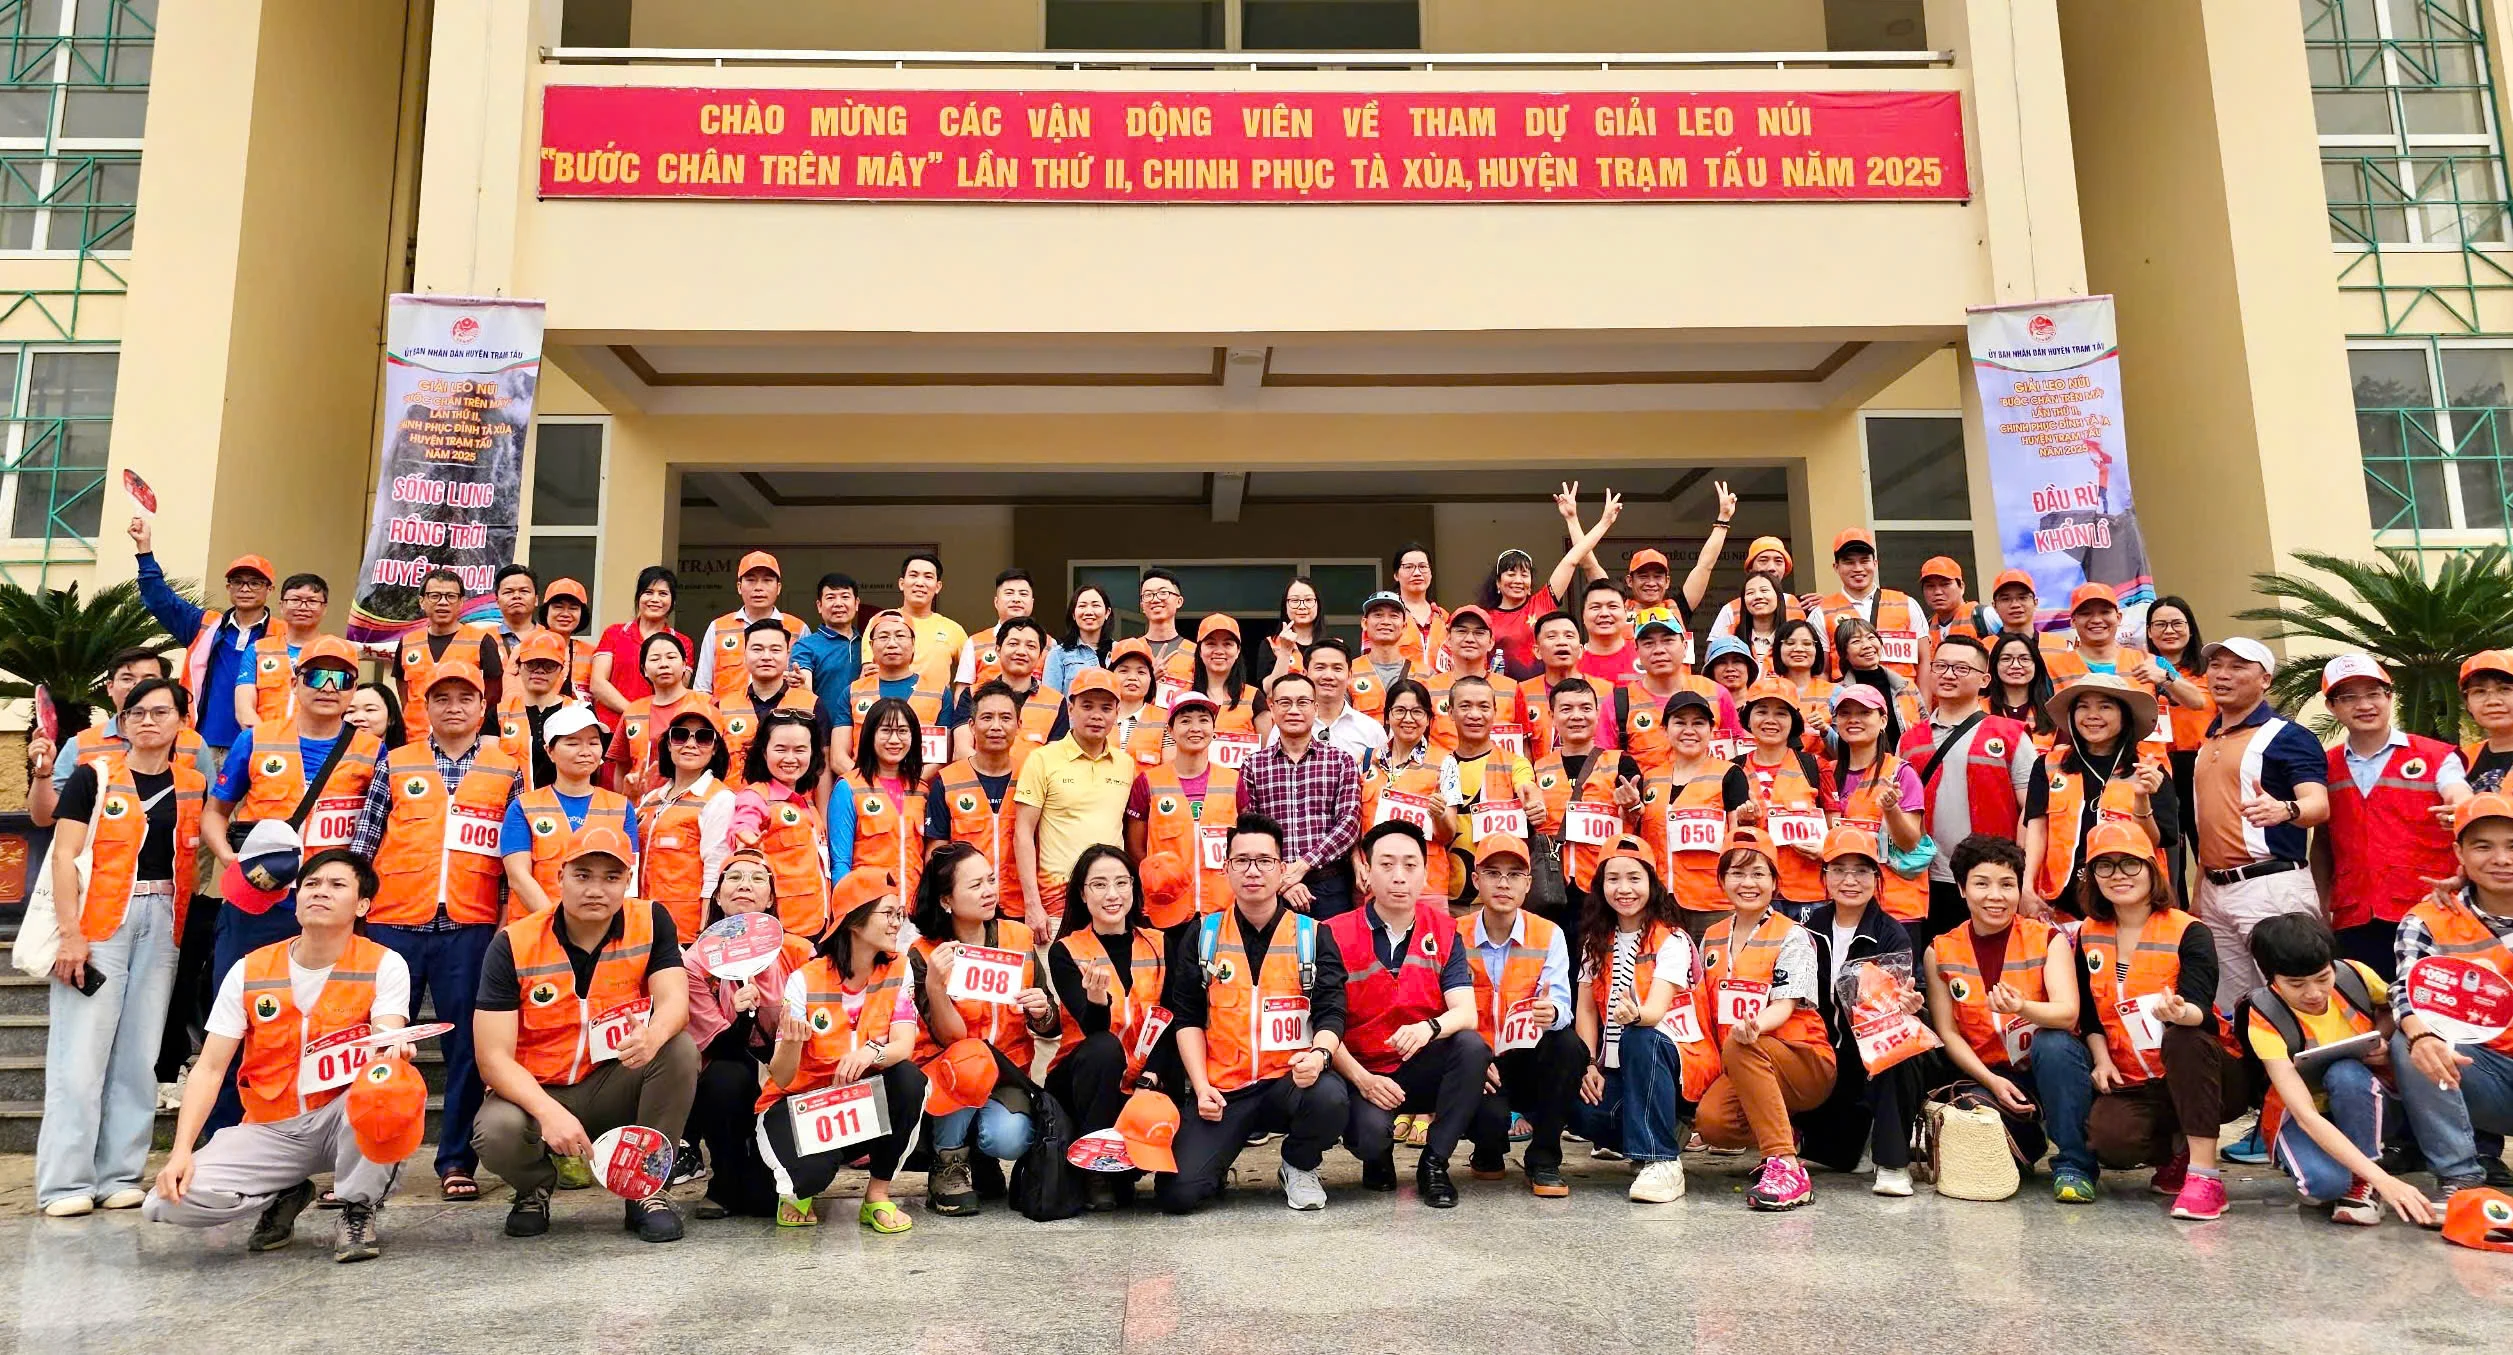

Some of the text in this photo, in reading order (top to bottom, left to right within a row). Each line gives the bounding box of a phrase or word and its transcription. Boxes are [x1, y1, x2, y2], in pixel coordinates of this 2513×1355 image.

[700, 96, 1812, 144] CHÀO MỪNG CÁC VẬN ĐỘNG VIÊN VỀ THAM DỰ GIẢI LEO NÚI
[540, 142, 640, 184] “BƯỚC
[657, 148, 744, 184] CHÂN
[760, 149, 841, 186] TRÊN
[856, 150, 943, 187] MÂY”
[957, 148, 1018, 189] LẦN
[1031, 151, 1095, 189] THỨ
[1105, 159, 1133, 193] II,
[1143, 158, 1238, 189] CHINH
[1251, 159, 1334, 195] PHỤC
[1350, 152, 1390, 189] TÀ
[1478, 153, 1578, 194] HUYỆN
[1595, 157, 1687, 193] TRẠM
[1703, 146, 1768, 188] TẤU
[1781, 150, 1855, 188] NĂM
[1866, 156, 1942, 187] 2025
[427, 348, 448, 358] NHÂN
[449, 349, 464, 358] DÂN
[465, 348, 488, 359] HUYỆN
[1998, 349, 2011, 359] BAN
[2012, 348, 2031, 358] NHÂN
[2048, 345, 2071, 356] HUYỆN
[2072, 343, 2090, 354] TRẠM
[418, 378, 499, 395] GIẢI LEO NÚI
[2014, 375, 2091, 393] GIẢI LEO NÚI
[433, 395, 462, 406] CHÂN
[463, 396, 488, 408] TRÊN
[2030, 394, 2059, 406] CHÂN
[2060, 392, 2083, 403] TRÊN
[429, 407, 450, 419] LẦN
[451, 407, 471, 420] THỨ
[2031, 405, 2051, 418] LẦN
[2052, 405, 2070, 417] THỨ
[424, 422, 453, 434] PHỤC
[453, 422, 480, 435] ĐỈNH
[2000, 423, 2030, 434] CHINH
[2030, 421, 2057, 433] PHỤC
[409, 433, 493, 449] HUYỆN TRẠM TẤU
[2021, 433, 2053, 446] HUYỆN
[2054, 431, 2081, 443] TRẠM
[425, 448, 477, 462] NĂM 2025
[2038, 443, 2089, 458] NĂM 2025
[392, 472, 495, 508] SỐNG LƯNG
[2032, 482, 2072, 514] ĐẦU
[389, 513, 488, 549] RỒNG TRỜI
[679, 559, 732, 576] TRẠM
[442, 565, 496, 594] HOẠI
[1884, 642, 1911, 658] 008
[320, 815, 357, 840] 005
[1389, 806, 1425, 829] 068
[1483, 814, 1517, 834] 020
[1582, 817, 1615, 838] 100
[460, 822, 499, 849] 009
[1681, 823, 1715, 844] 050
[1781, 821, 1822, 841] 004
[965, 965, 1010, 995] 098
[1732, 997, 1761, 1020] 03
[1272, 1015, 1302, 1044] 090
[1505, 1016, 1538, 1044] 073
[317, 1046, 369, 1081] 014
[815, 1107, 861, 1143] 011
